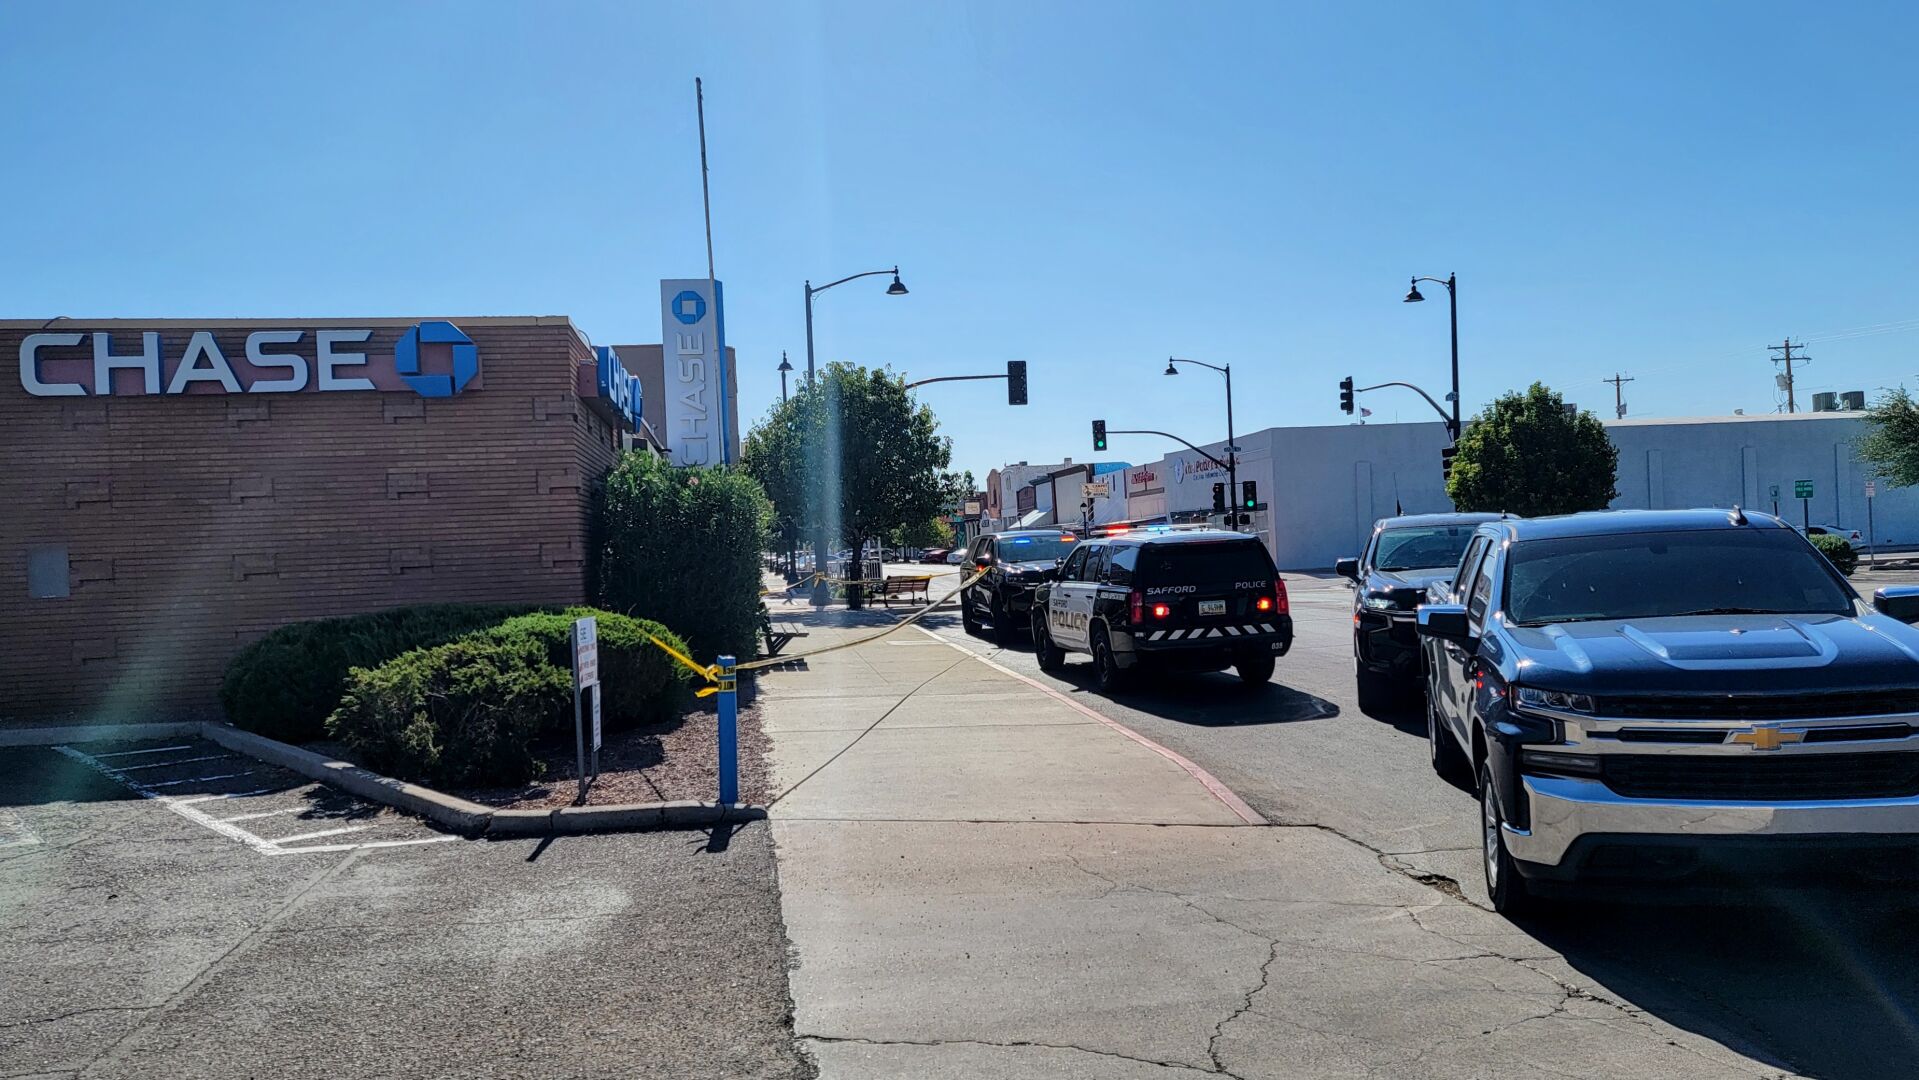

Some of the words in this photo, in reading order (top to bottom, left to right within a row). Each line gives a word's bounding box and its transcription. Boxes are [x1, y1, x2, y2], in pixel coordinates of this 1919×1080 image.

[19, 330, 377, 396] CHASE
[677, 332, 709, 466] CHASE
[1147, 585, 1197, 595] SAFFORD
[1235, 580, 1267, 590] POLICE
[1052, 609, 1088, 631] POLICE
